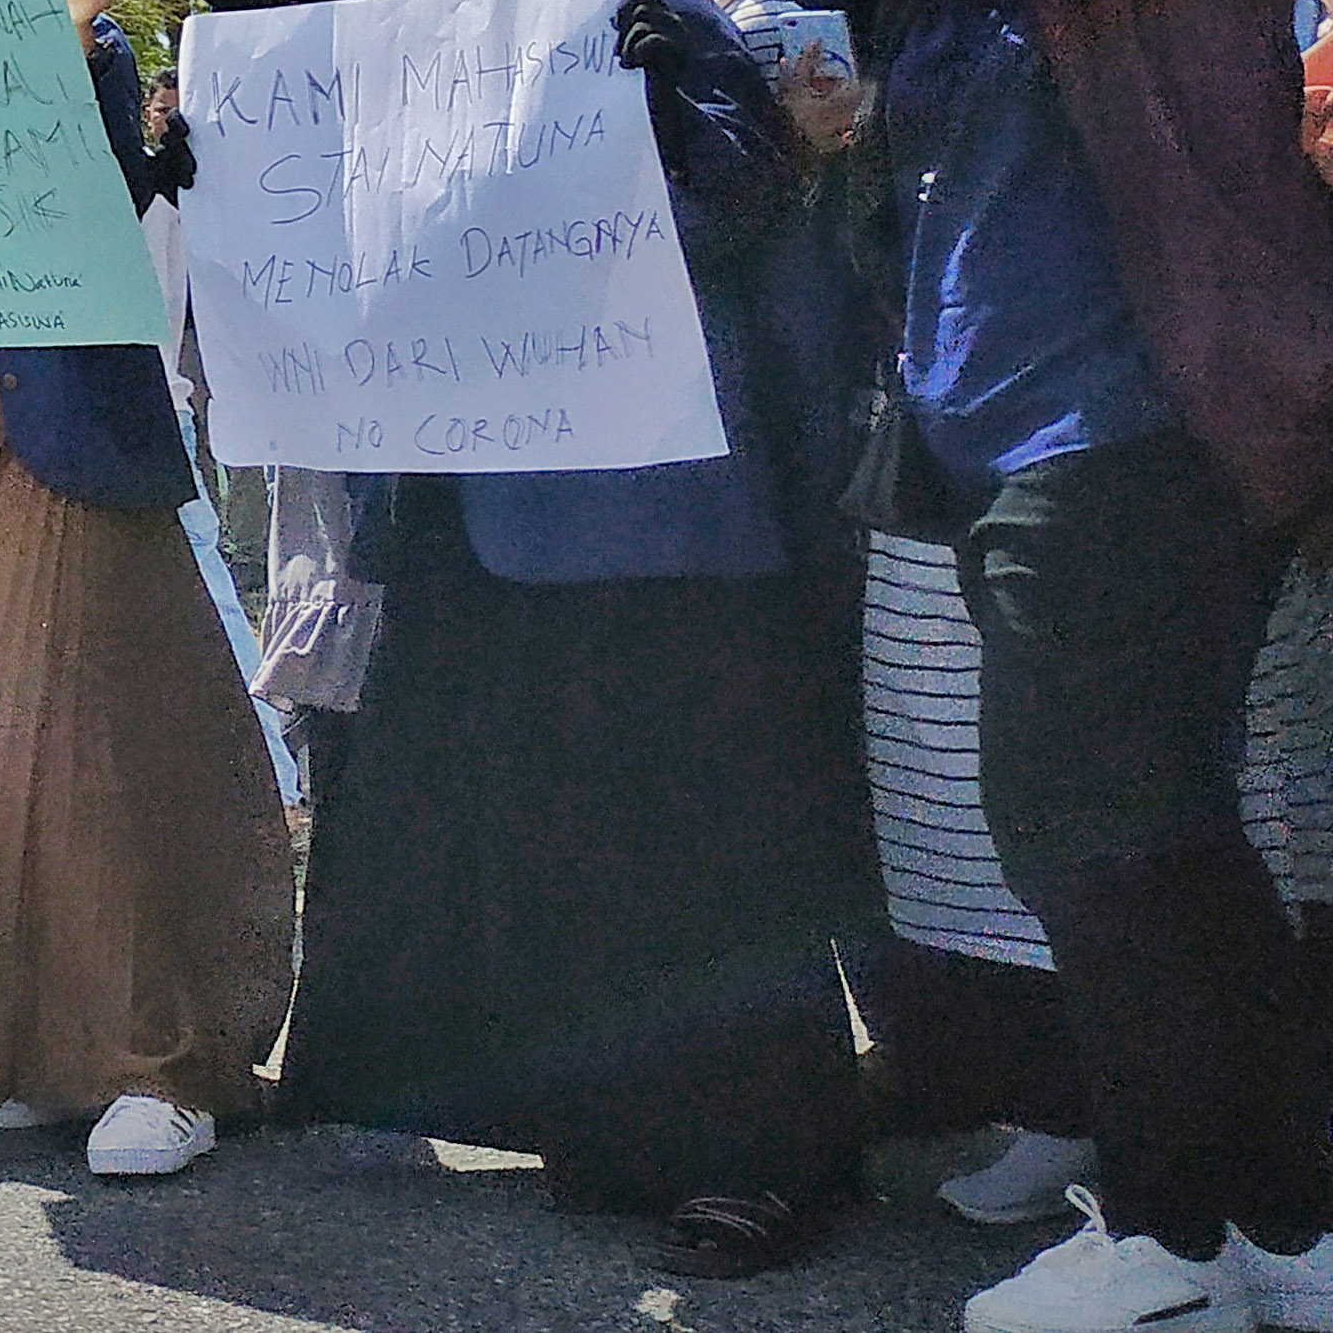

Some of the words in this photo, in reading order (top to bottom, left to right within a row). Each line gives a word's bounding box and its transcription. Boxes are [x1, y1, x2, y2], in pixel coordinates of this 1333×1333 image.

[207, 62, 361, 138] KAMI
[259, 144, 391, 225] STAI
[413, 109, 607, 186] NATUNA
[242, 247, 434, 309] MENOLAK
[343, 337, 461, 387] DARI
[480, 317, 654, 378] WUHAN
[336, 416, 384, 454] NO
[414, 408, 575, 455] CORONA
